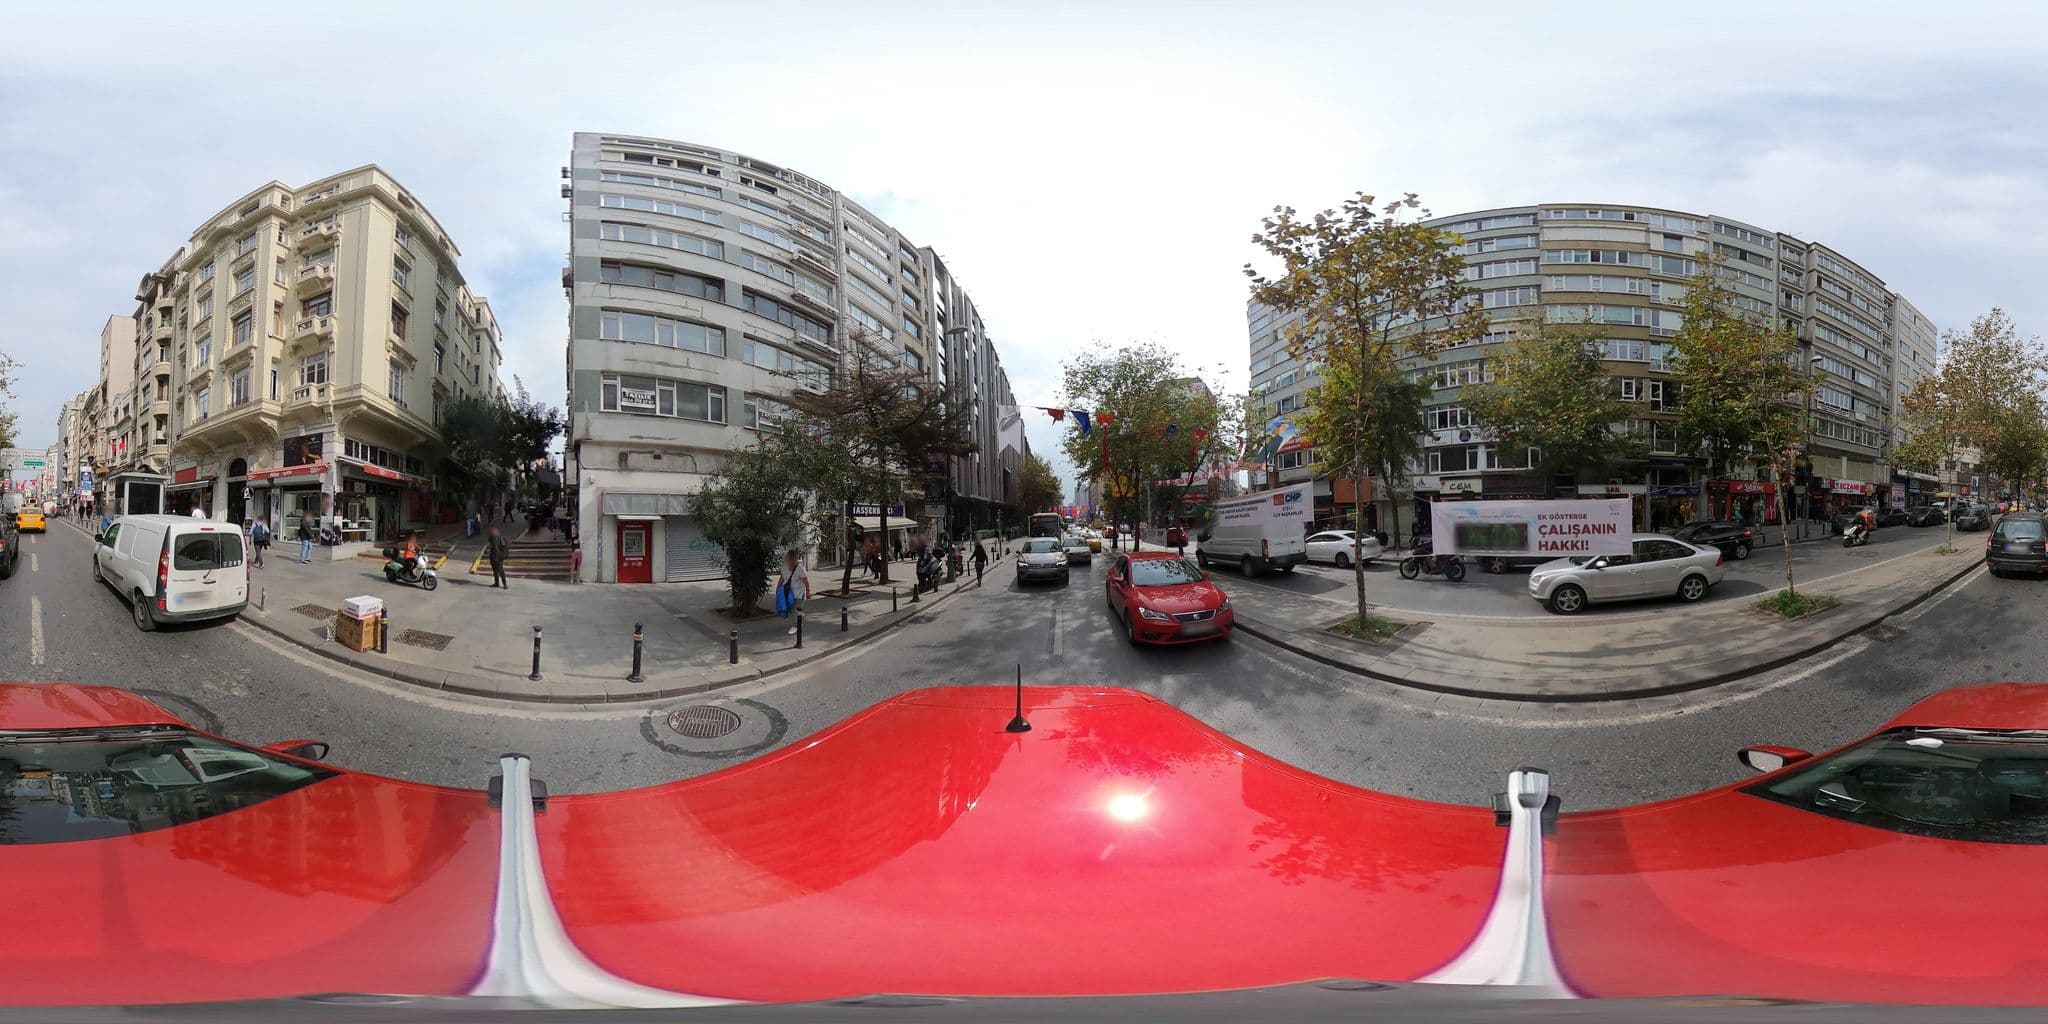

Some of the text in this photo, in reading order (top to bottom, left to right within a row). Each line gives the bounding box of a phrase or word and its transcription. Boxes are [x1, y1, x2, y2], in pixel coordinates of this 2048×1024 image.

[1285, 492, 1301, 502] CHP
[1549, 511, 1588, 520] GÖSTERGE
[1538, 523, 1617, 538] ÇALIŞANIN
[1538, 540, 1589, 551] HAKKI!
